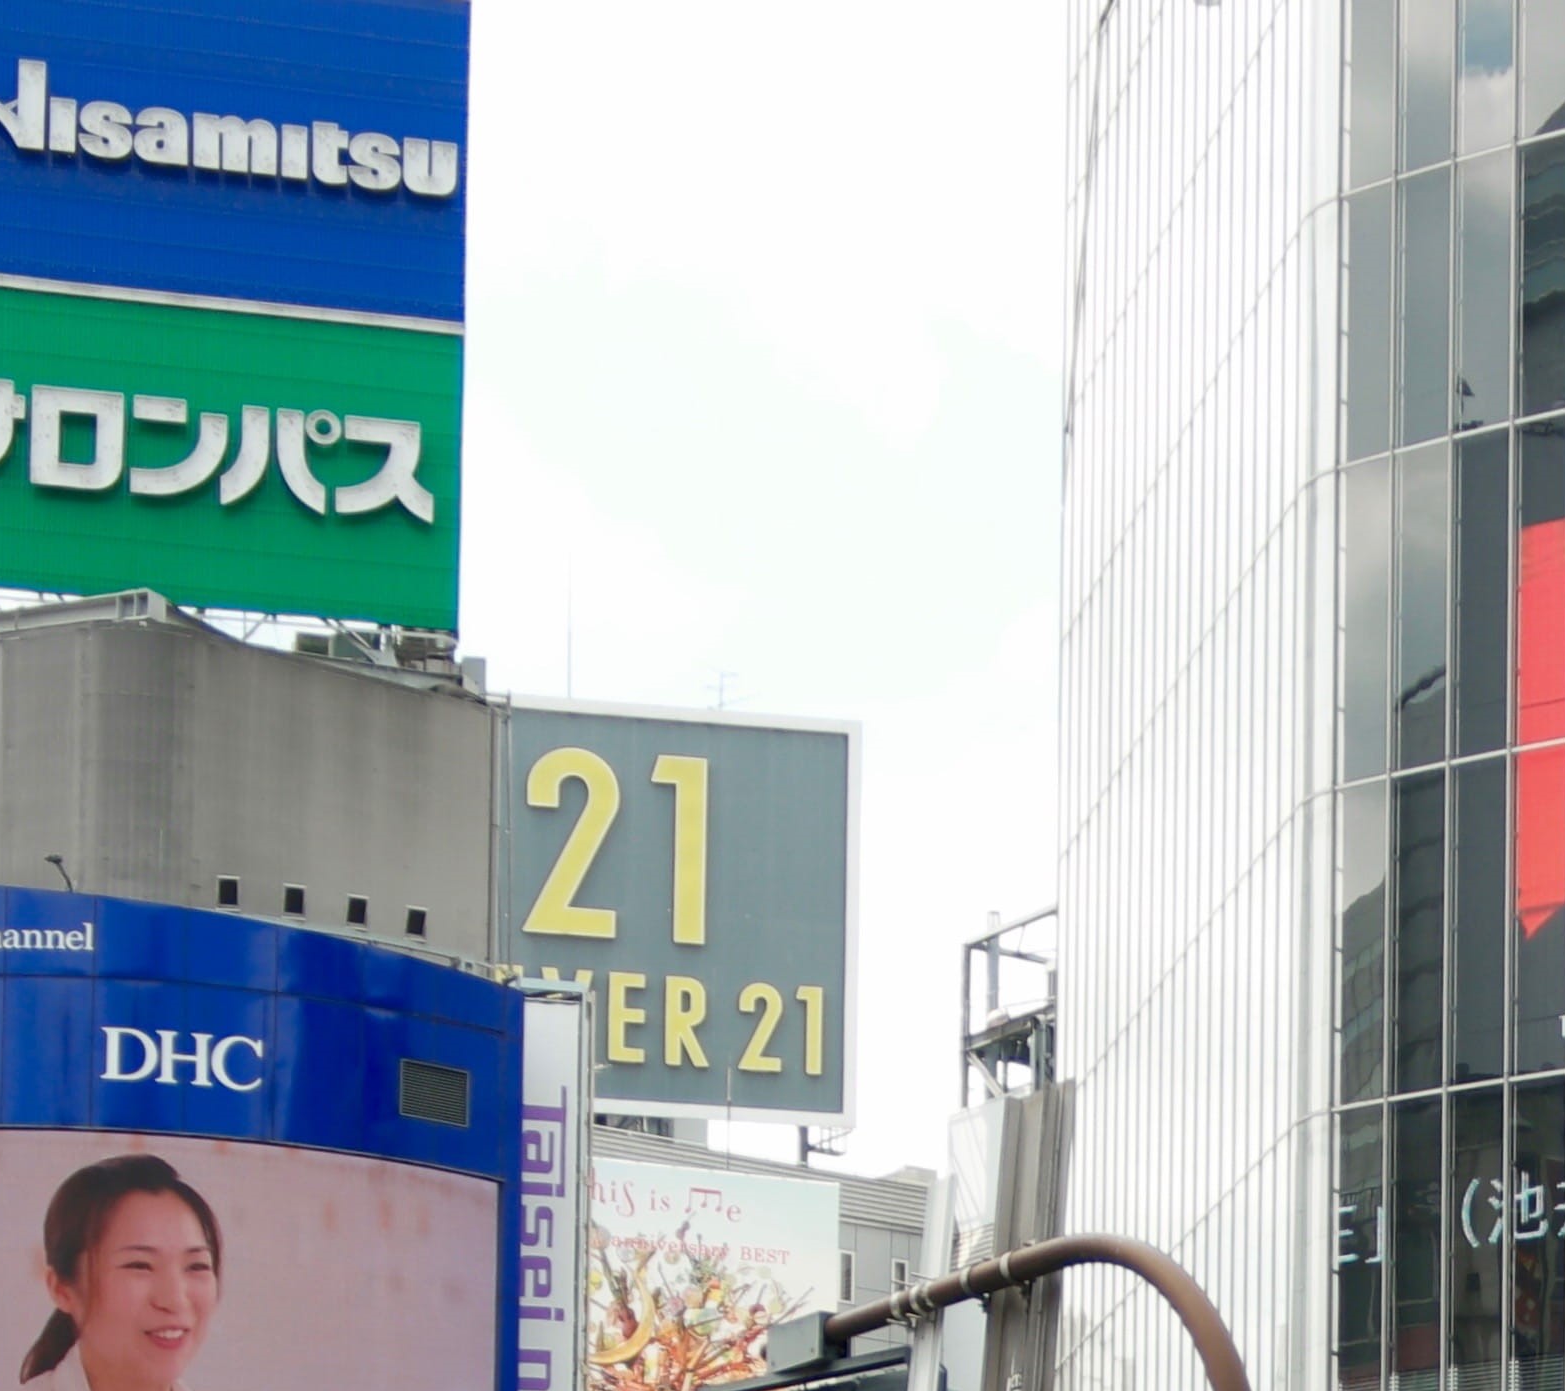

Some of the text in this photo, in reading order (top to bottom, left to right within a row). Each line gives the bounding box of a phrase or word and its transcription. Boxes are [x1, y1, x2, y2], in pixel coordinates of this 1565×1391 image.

[523, 747, 707, 945] 21
[101, 1026, 265, 1091] DHC
[739, 983, 823, 1075] 21
[518, 1086, 568, 1324] Taisei
[739, 1246, 791, 1266] BEST
